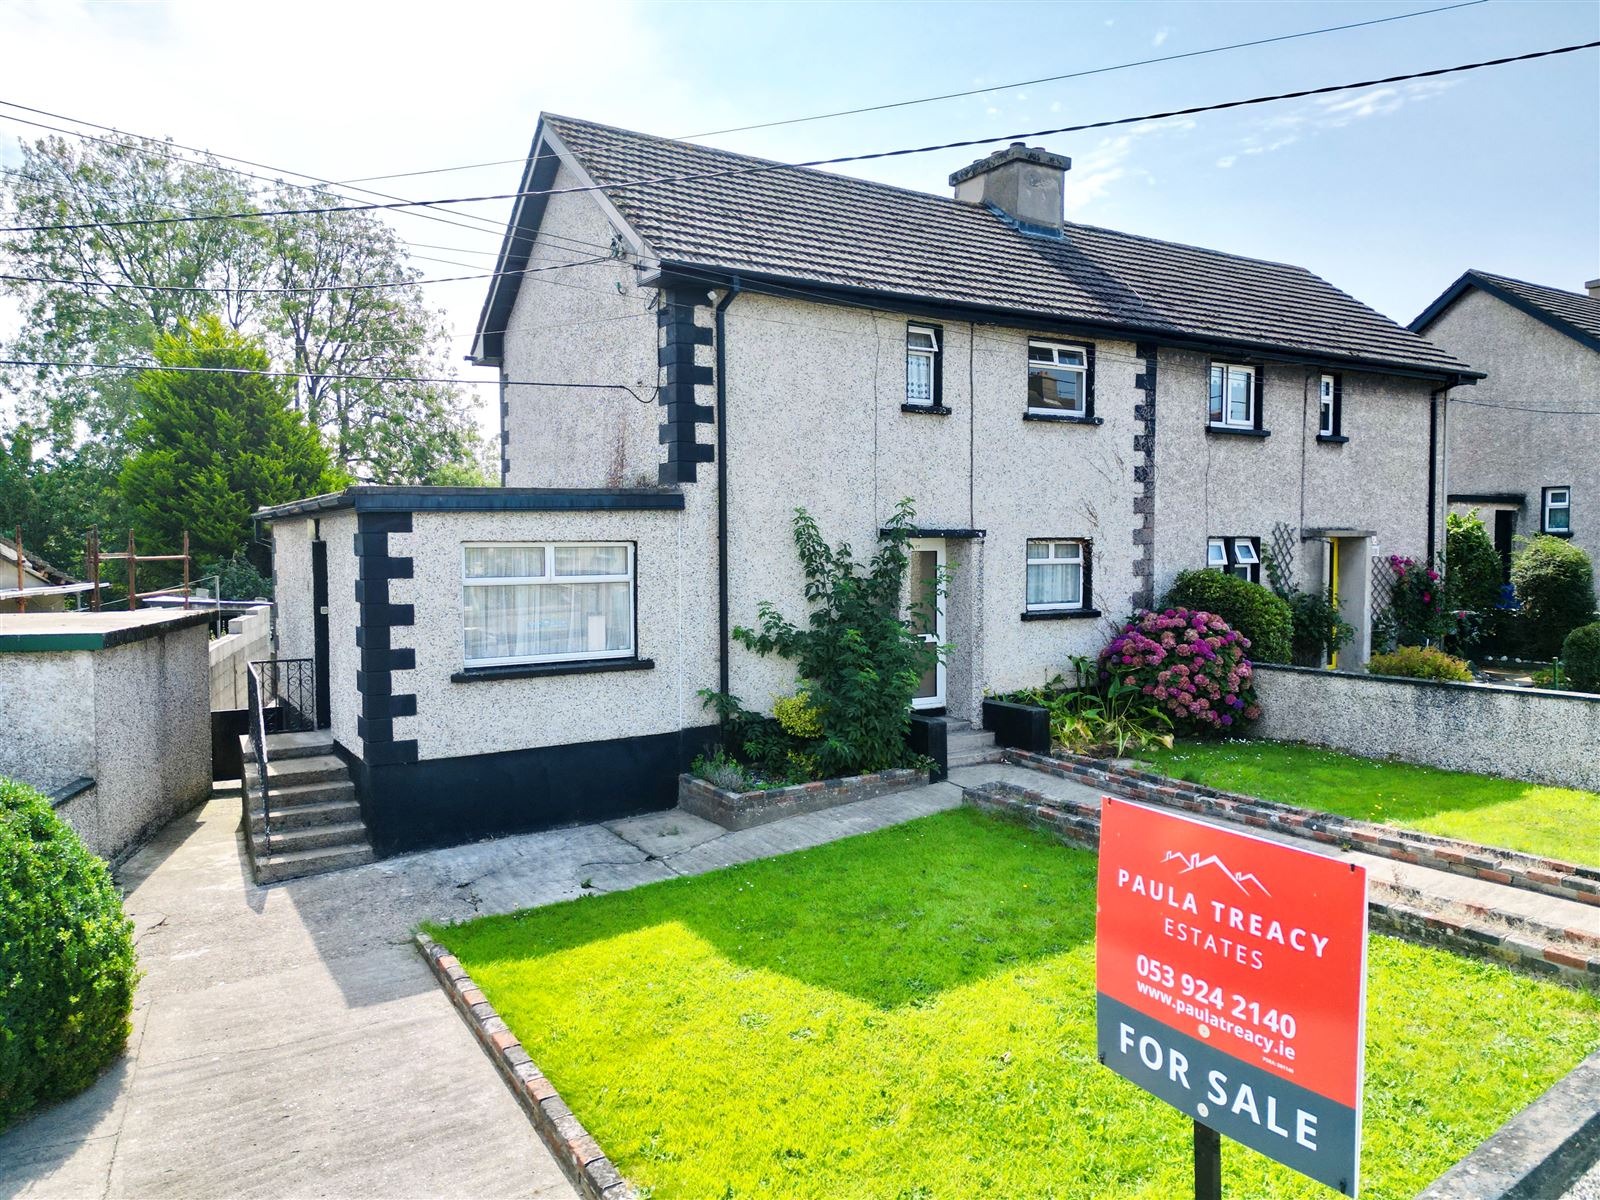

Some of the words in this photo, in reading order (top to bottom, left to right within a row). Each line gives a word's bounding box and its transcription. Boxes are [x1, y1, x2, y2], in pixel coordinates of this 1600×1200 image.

[1118, 868, 1198, 914] PAULA
[1211, 900, 1329, 958] TREACY
[1164, 917, 1264, 970] ESTATES
[1136, 954, 1175, 988] 053
[1181, 973, 1224, 1010] 924
[1231, 994, 1297, 1040] 2140
[1136, 980, 1296, 1061] www.paulatreacy.ie
[1119, 1022, 1191, 1090] FOR
[1207, 1070, 1318, 1151] SALE
